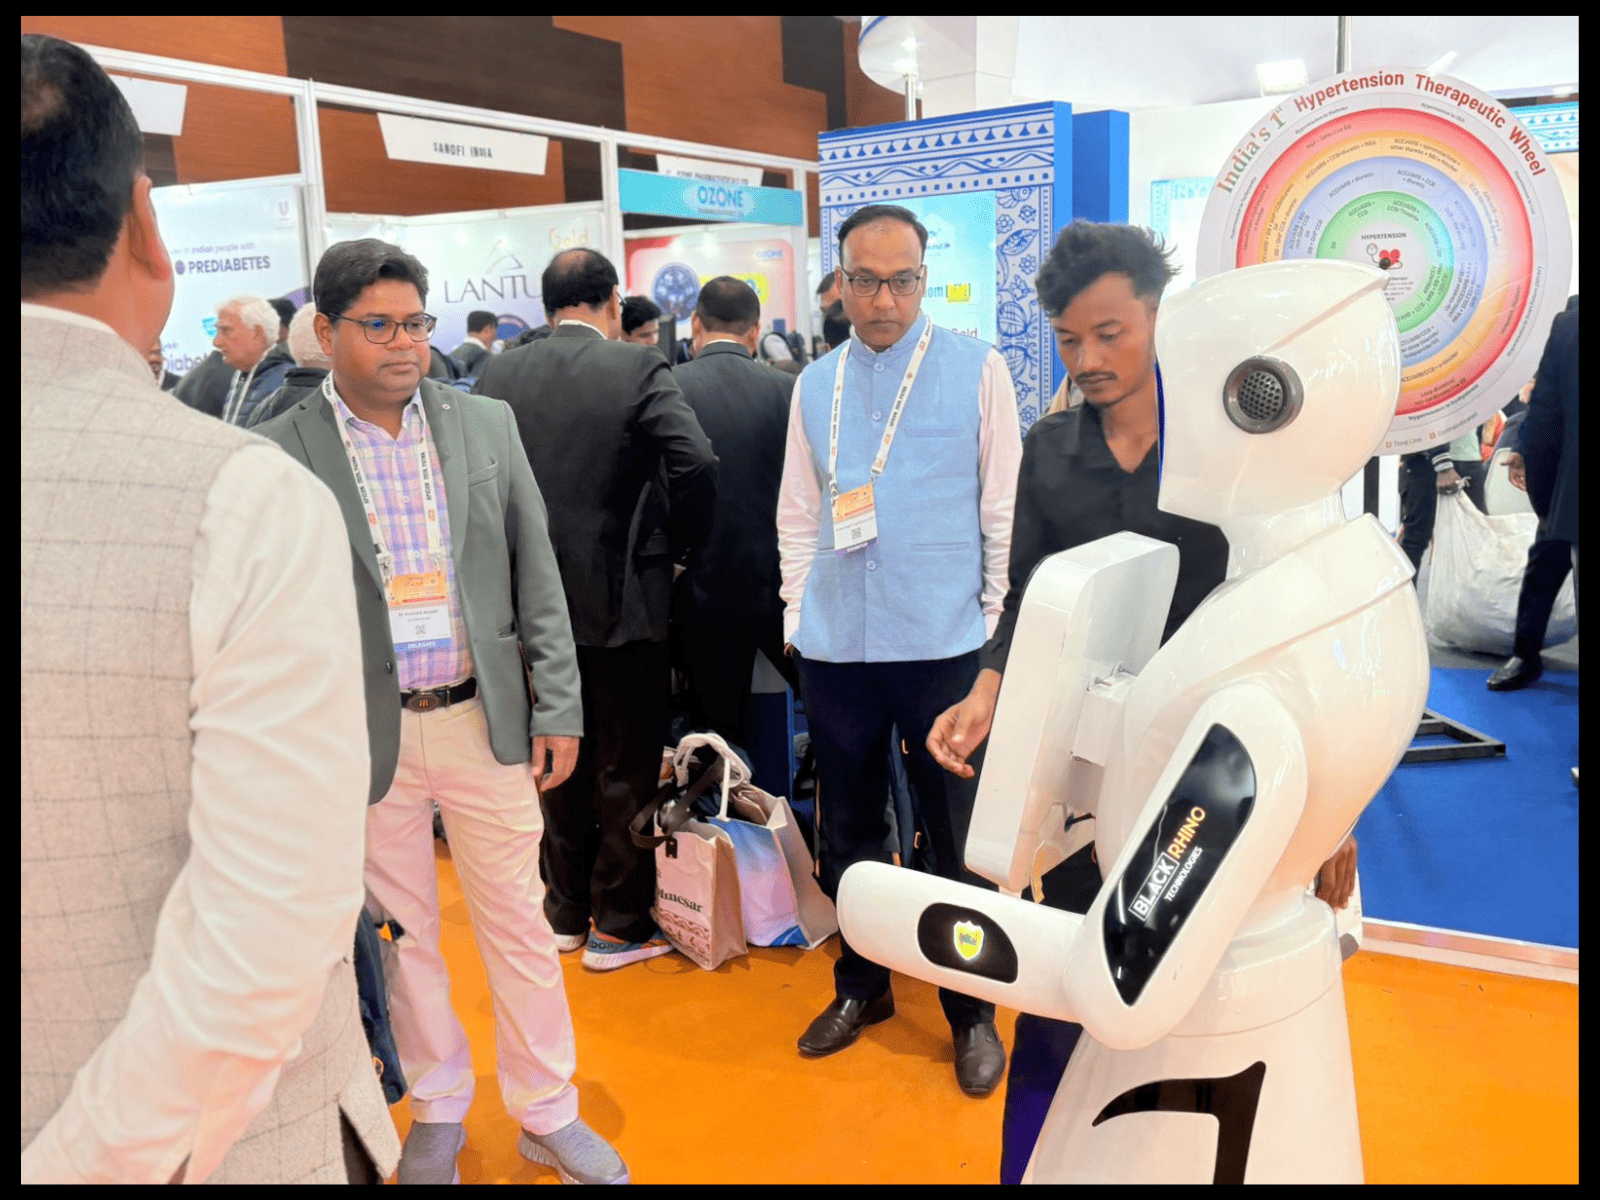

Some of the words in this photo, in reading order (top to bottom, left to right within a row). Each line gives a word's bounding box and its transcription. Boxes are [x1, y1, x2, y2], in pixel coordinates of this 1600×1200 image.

[1216, 126, 1272, 194] India's
[1293, 70, 1404, 112] Hypertension
[1415, 74, 1506, 128] Therapeutic
[1509, 126, 1546, 176] Wheel
[432, 142, 464, 156] SANOFI
[698, 185, 744, 208] OZONE
[1362, 232, 1406, 240] HYPERTENSION
[188, 256, 270, 273] PREDIABETES
[444, 274, 542, 304] LANTU
[1132, 858, 1175, 916] BLACK
[1167, 806, 1206, 859] RHINO
[1164, 846, 1203, 902] TECHNOLOGIES
[658, 889, 704, 912] lmesar
